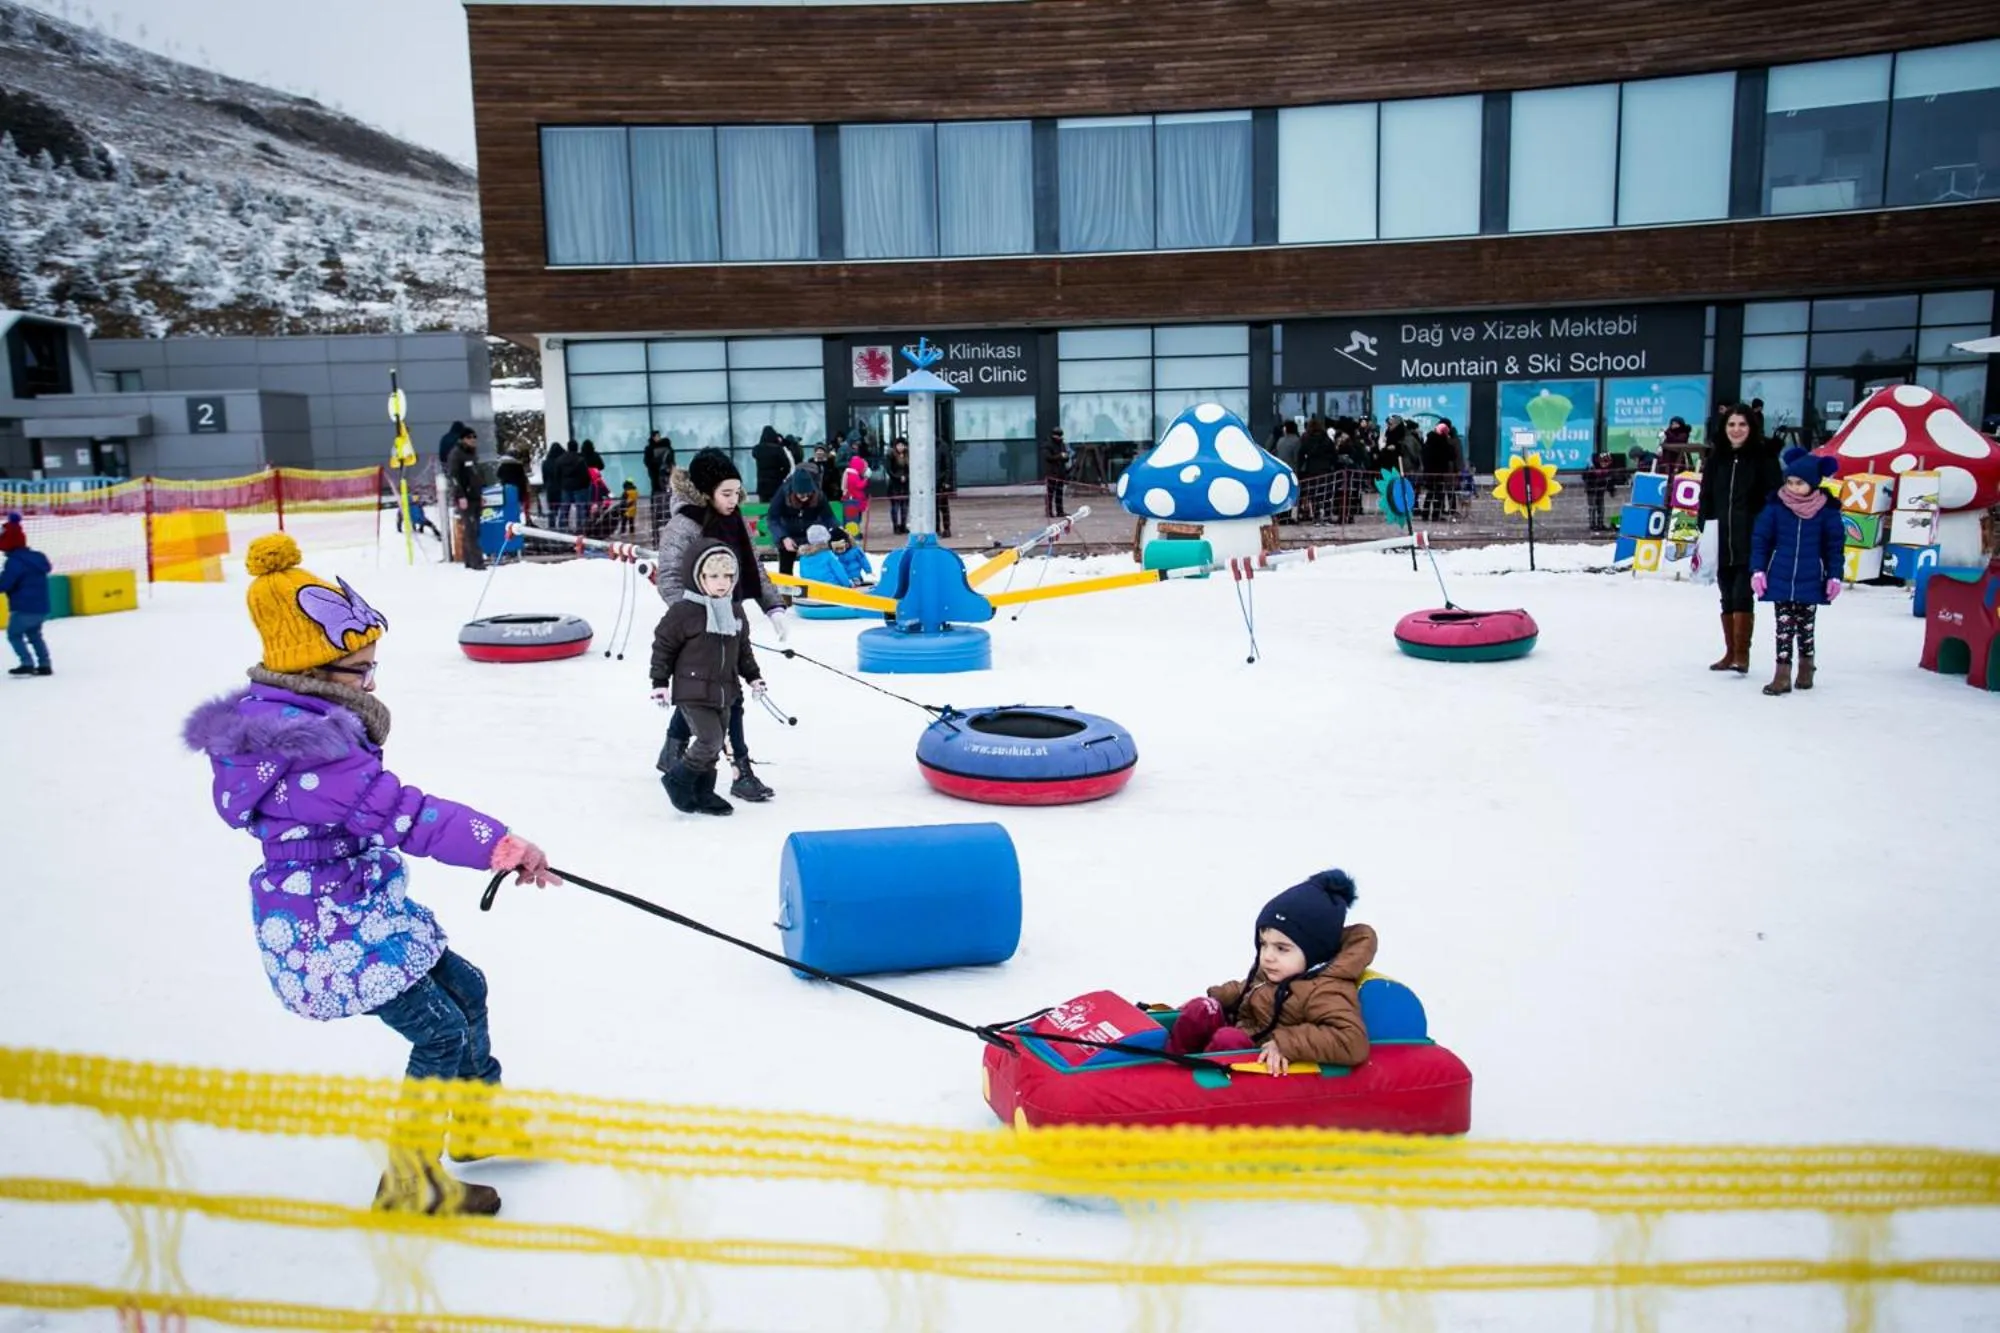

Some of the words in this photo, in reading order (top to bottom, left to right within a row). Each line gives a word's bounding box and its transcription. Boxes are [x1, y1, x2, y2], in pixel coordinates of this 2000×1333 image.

[1401, 323, 1443, 347] Dağ
[1450, 326, 1475, 341] və
[1482, 320, 1542, 340] Xizək
[1550, 314, 1637, 337] Məktəbi
[949, 343, 1022, 359] Klinikası
[979, 365, 1027, 383] Clinic
[1401, 356, 1498, 378] Mountain
[1505, 355, 1520, 374] &
[1528, 353, 1561, 373] Ski
[1569, 350, 1646, 372] School
[198, 404, 214, 425] 2
